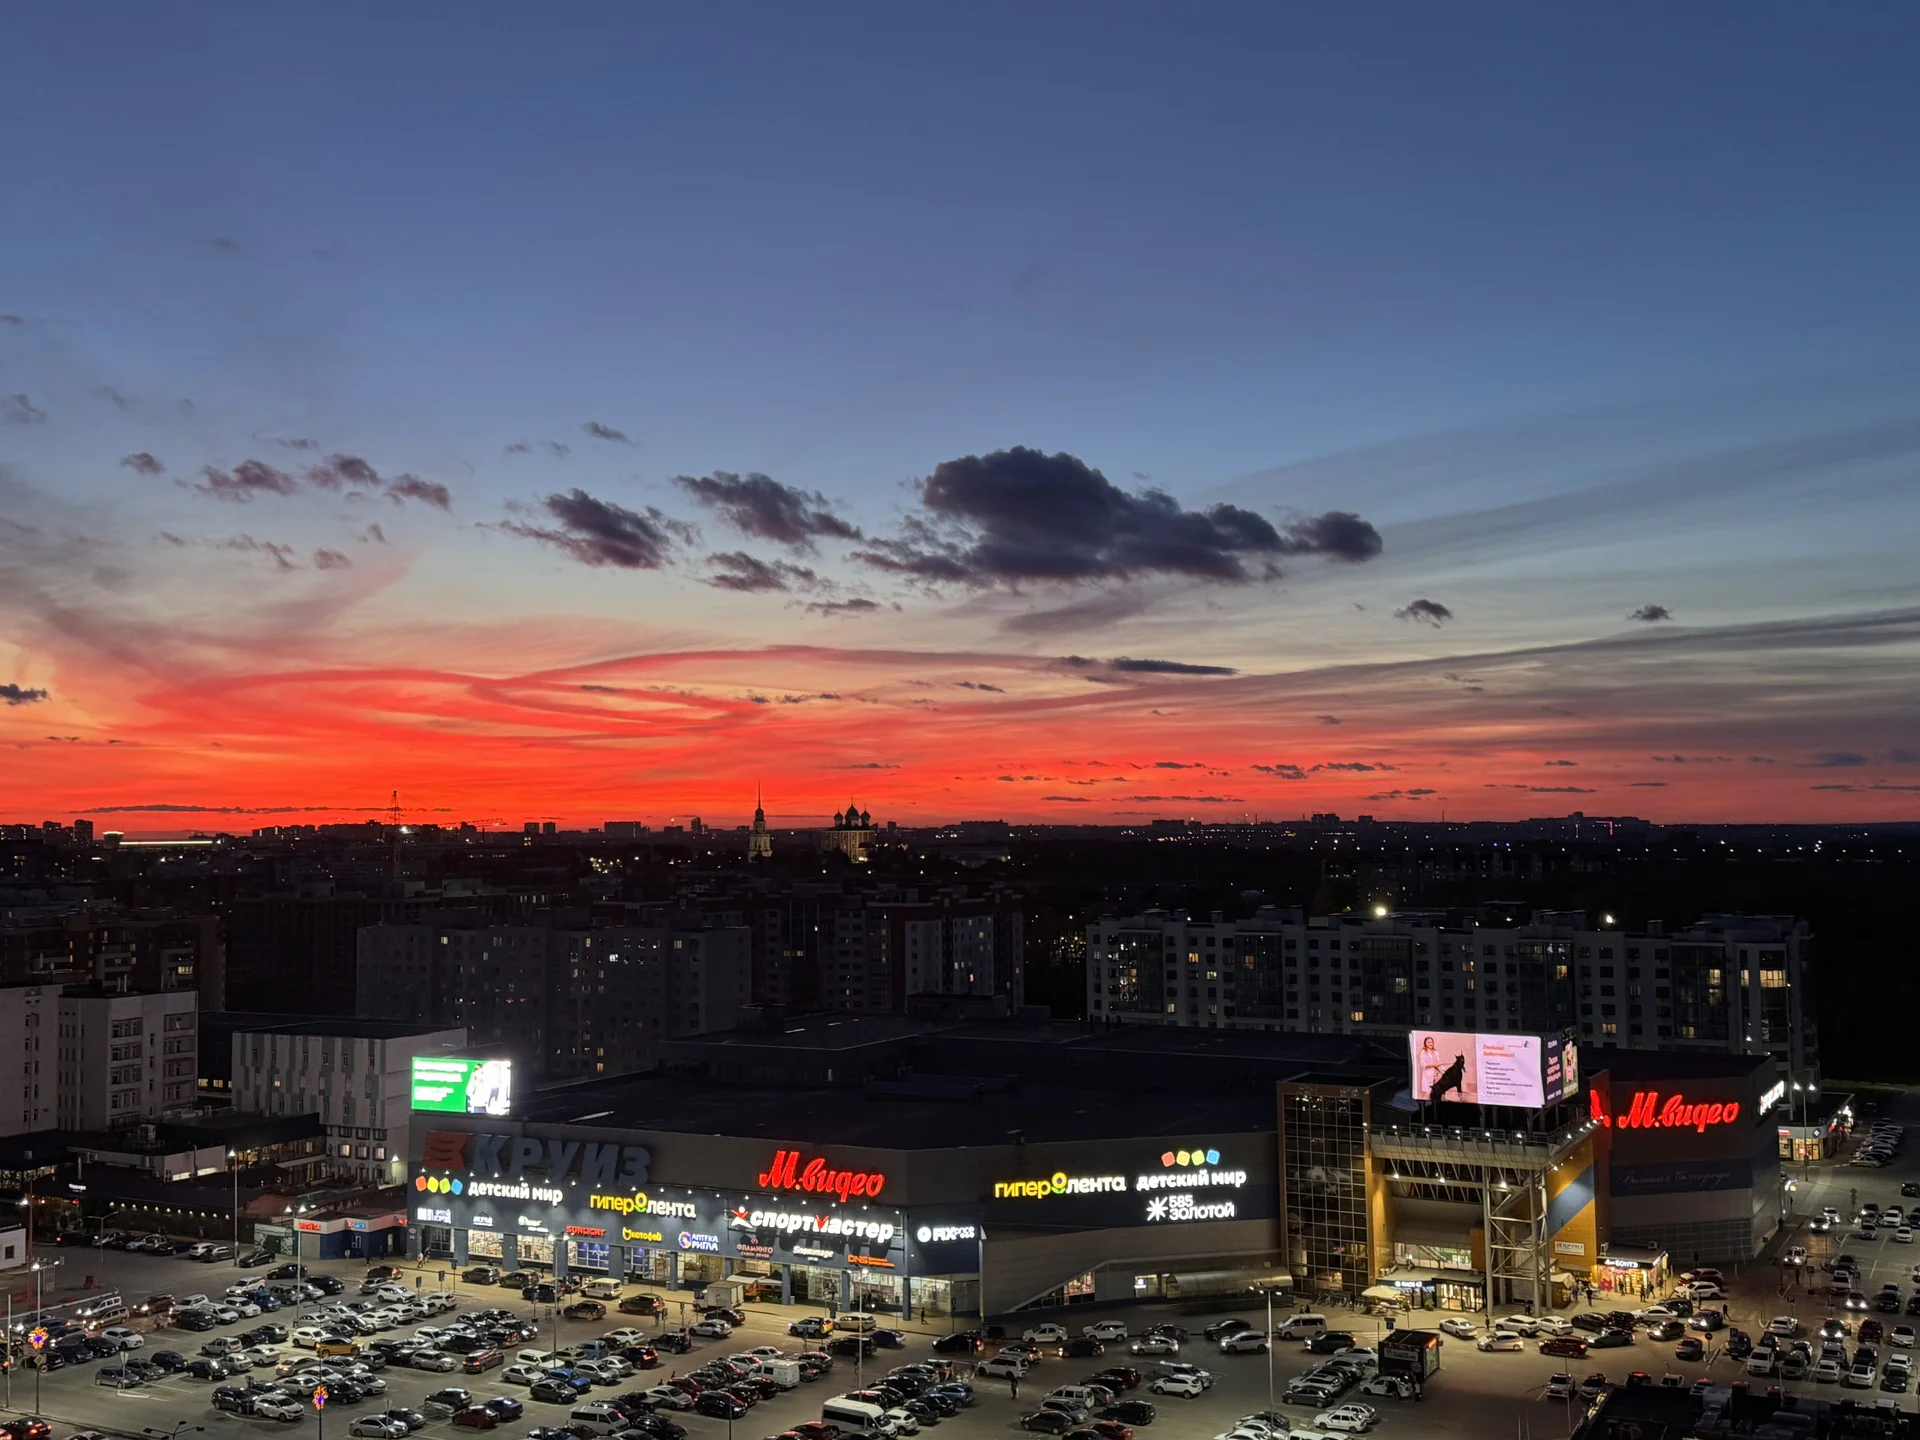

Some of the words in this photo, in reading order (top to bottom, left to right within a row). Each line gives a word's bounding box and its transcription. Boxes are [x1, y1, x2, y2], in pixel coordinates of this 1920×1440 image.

[1618, 1091, 1740, 1133] М.видео
[472, 1133, 651, 1186] КРУИЗ
[759, 1150, 885, 1202] М.видео
[994, 1180, 1051, 1199] гипер
[1065, 1175, 1127, 1195] лента
[1136, 1169, 1209, 1191] детский
[1214, 1170, 1247, 1189] мир
[468, 1181, 530, 1200] детский
[532, 1186, 564, 1206] мир
[1168, 1194, 1194, 1208] 585
[590, 1193, 634, 1216] гипер
[645, 1198, 697, 1220] лента
[1169, 1202, 1235, 1222] ЗОЛОТОЙ
[631, 1232, 662, 1243] котофей
[750, 1210, 894, 1243] спортмастер
[692, 1240, 719, 1252] РИГЛА
[736, 1244, 774, 1254] ФЛАМИНГО
[847, 1254, 869, 1264] DNS
